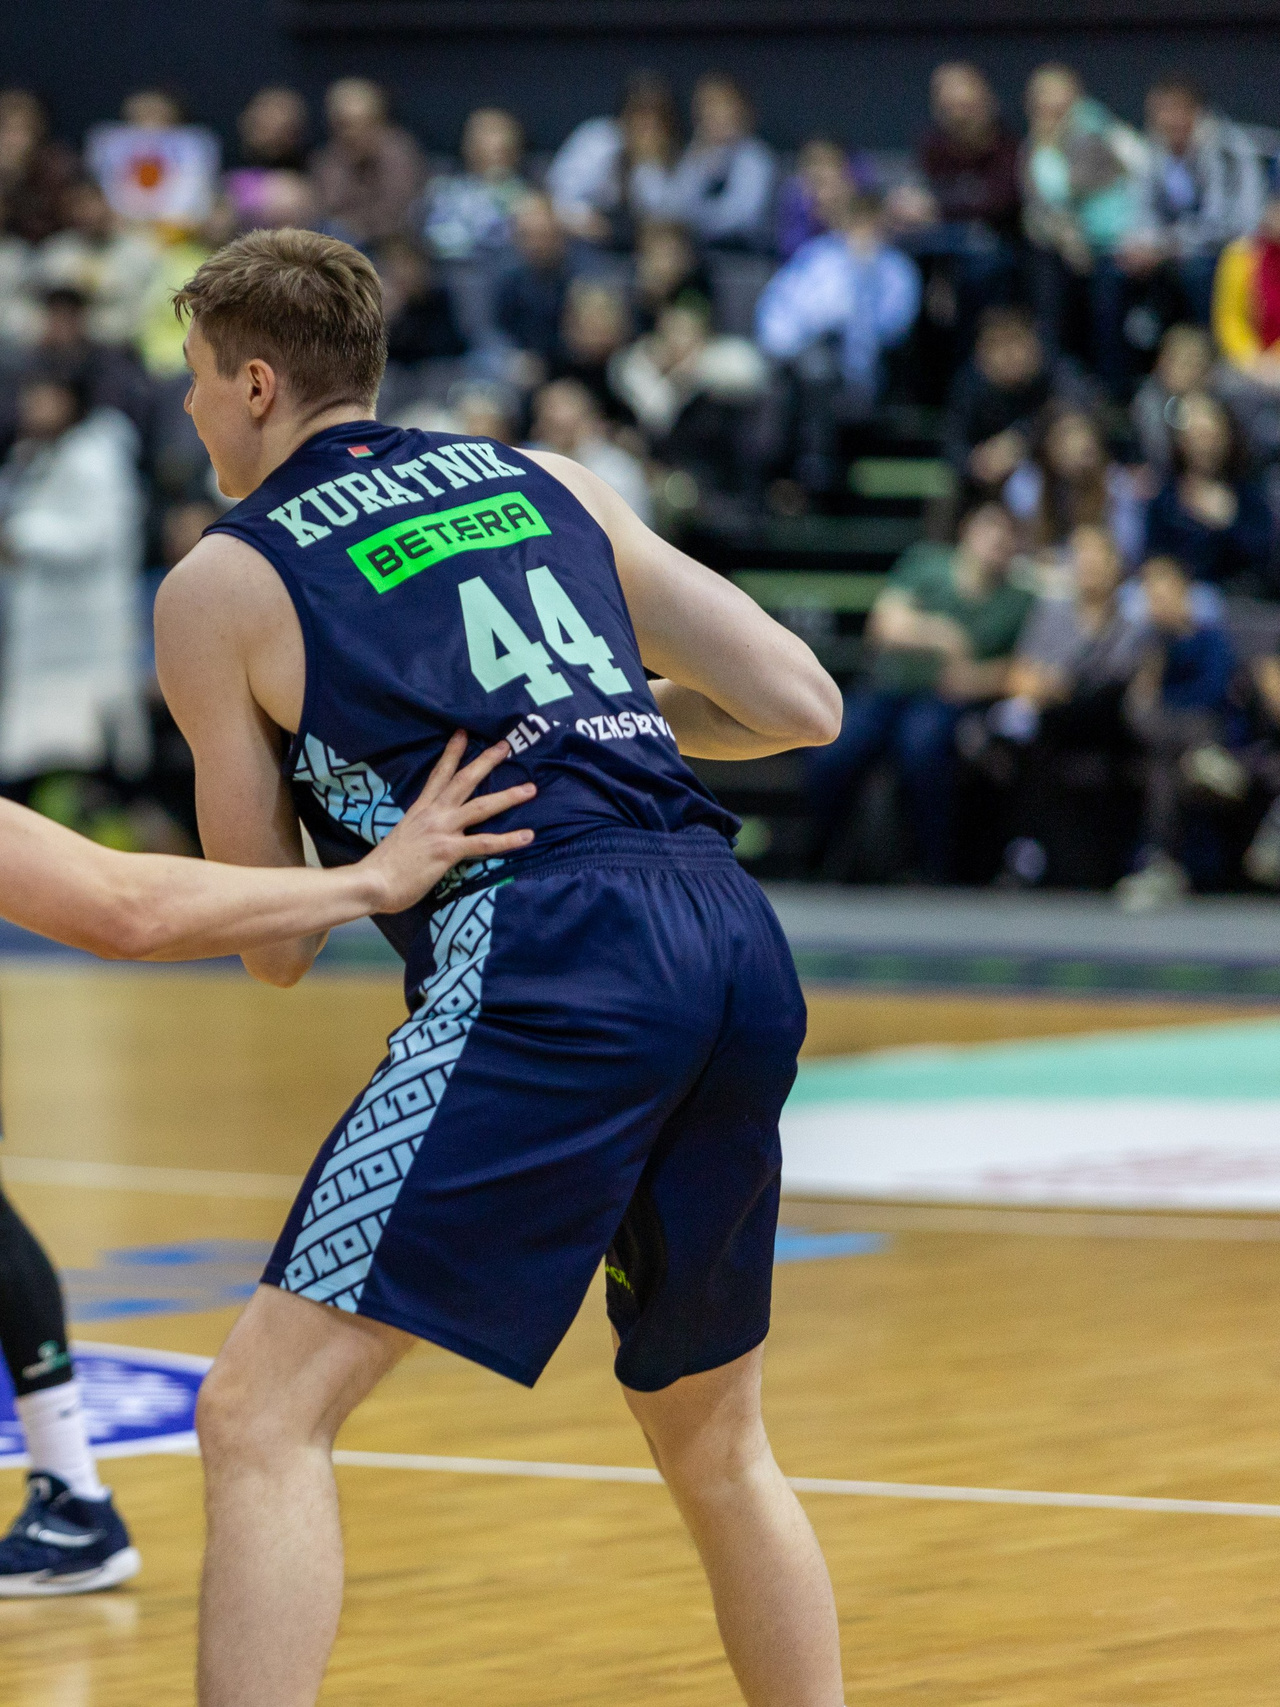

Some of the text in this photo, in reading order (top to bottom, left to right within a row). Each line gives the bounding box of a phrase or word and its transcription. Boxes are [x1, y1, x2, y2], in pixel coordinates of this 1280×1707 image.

[266, 442, 526, 548] KURATNIK
[368, 503, 536, 578] BETERA
[458, 565, 632, 706] 44
